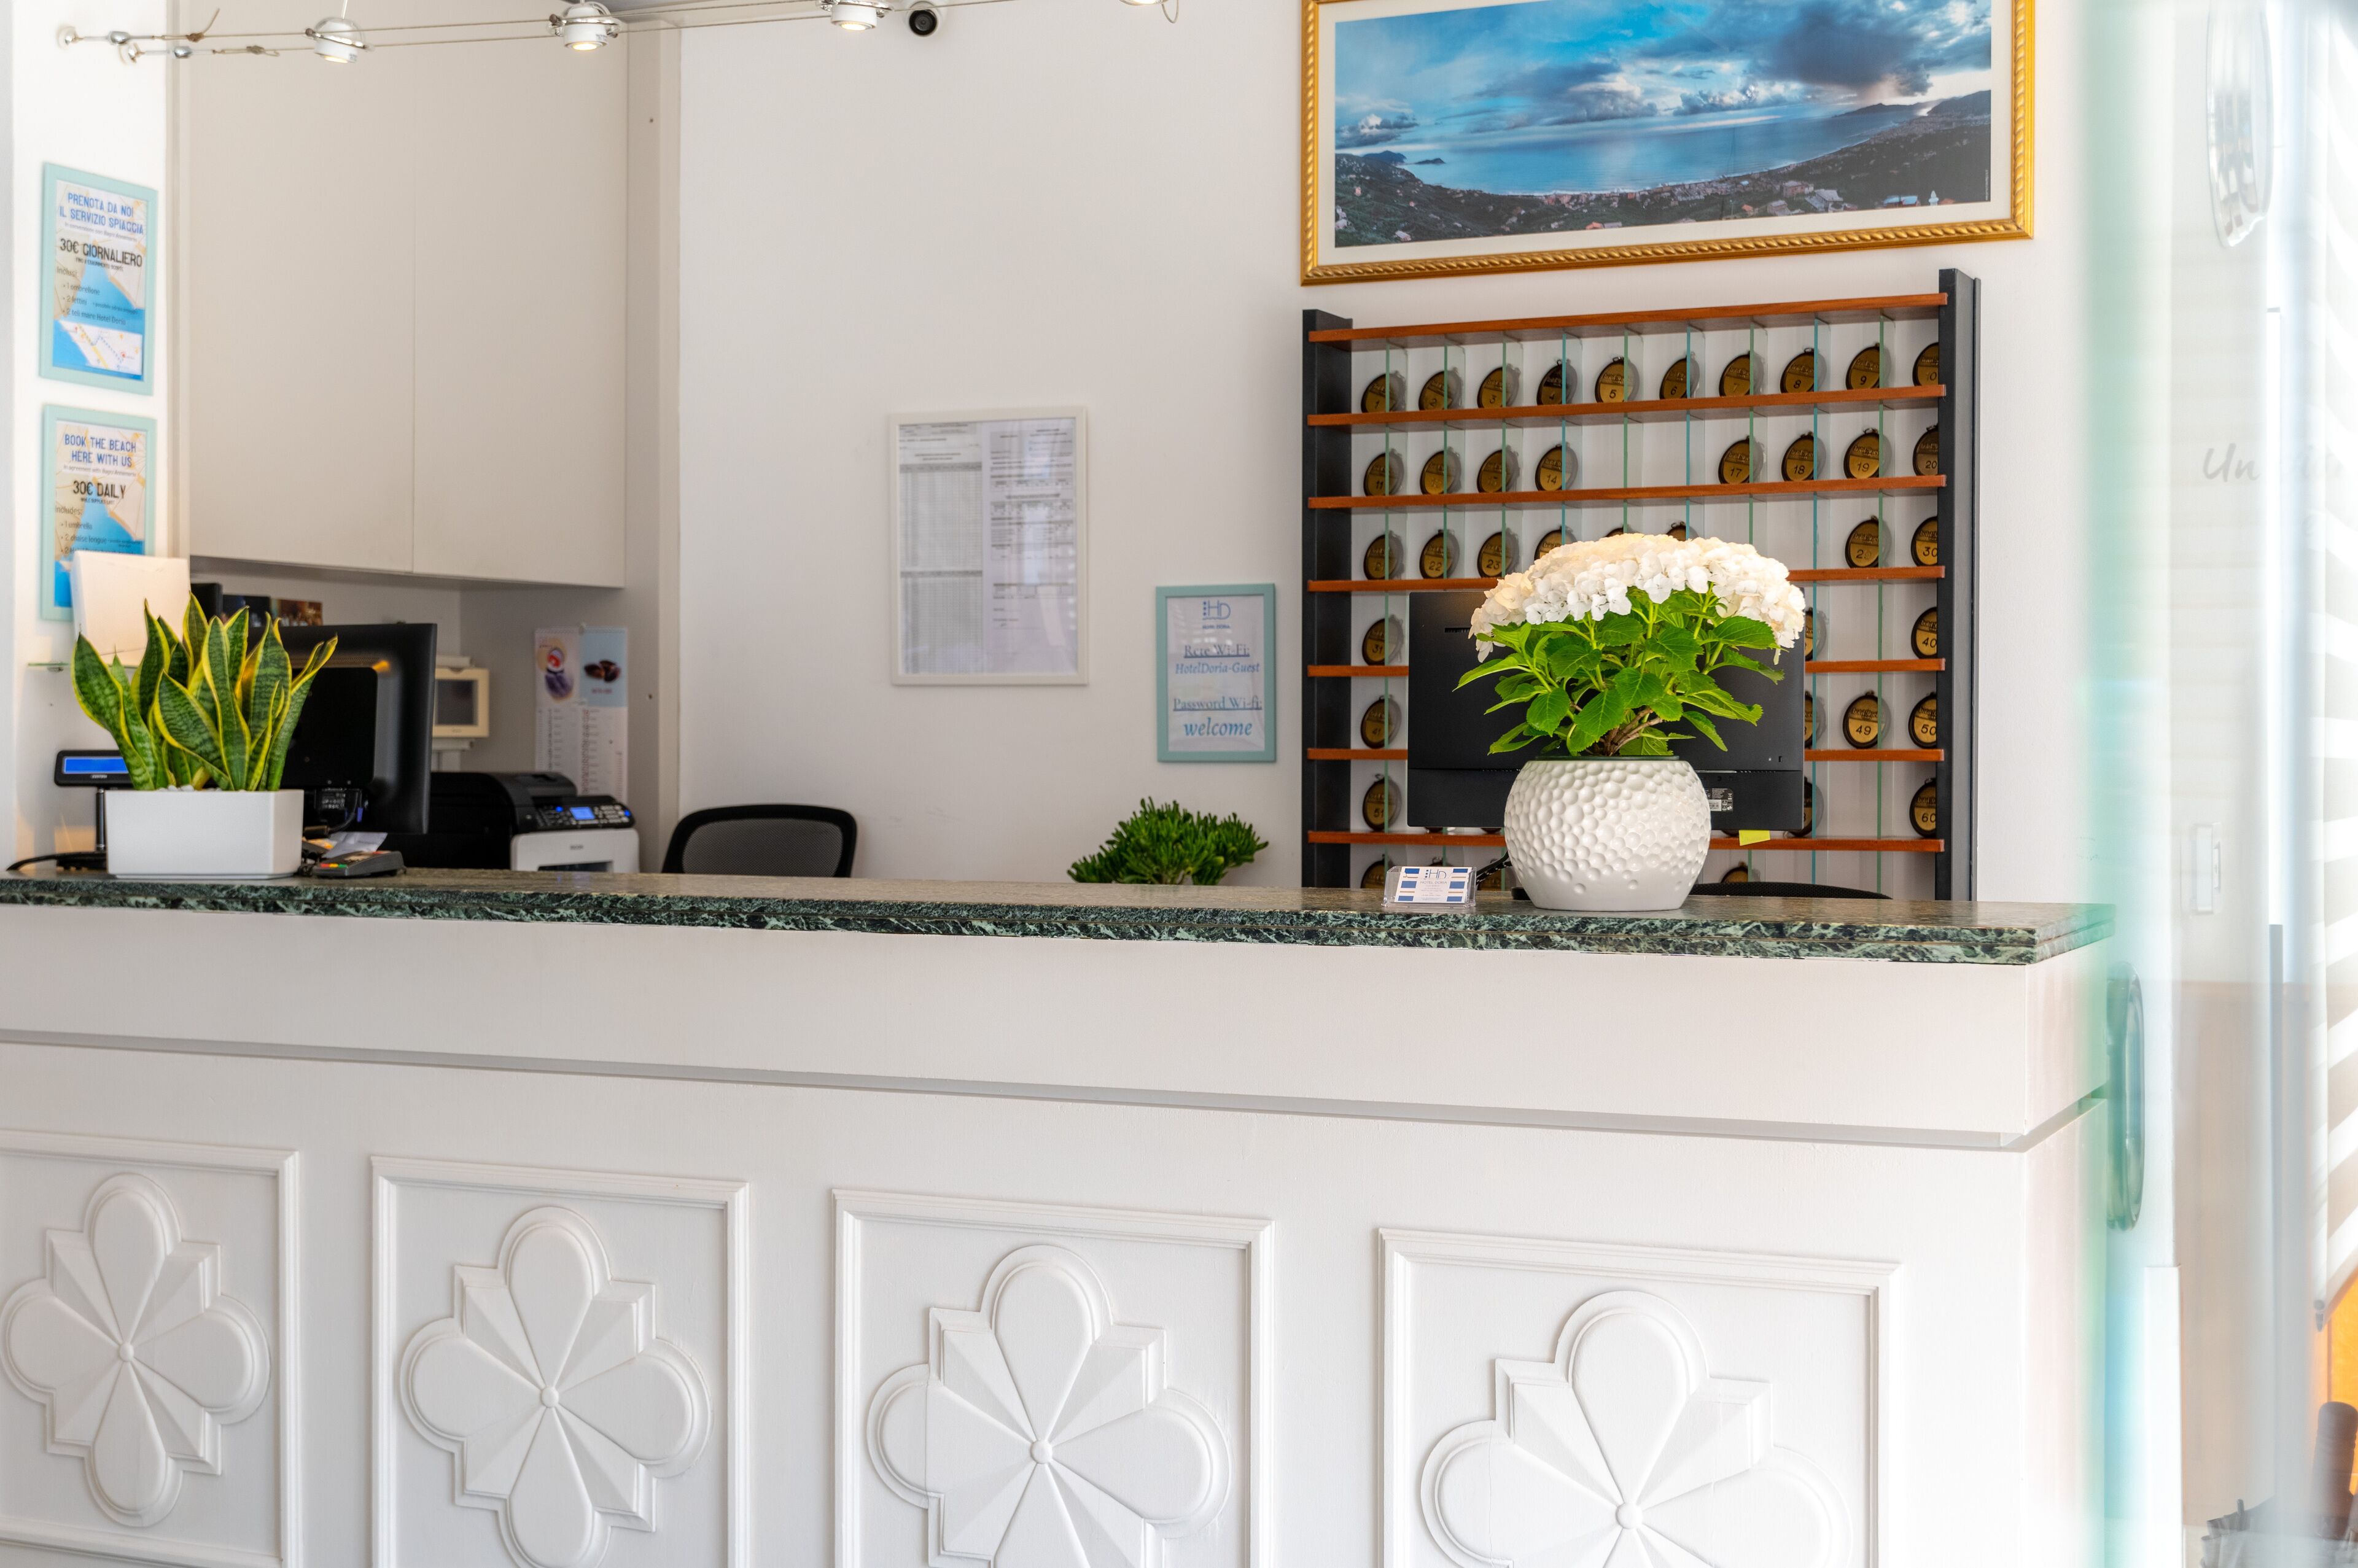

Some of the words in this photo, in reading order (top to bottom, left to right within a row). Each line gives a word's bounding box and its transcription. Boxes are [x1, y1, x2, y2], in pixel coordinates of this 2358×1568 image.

[68, 192, 104, 211] PRENOTA
[107, 202, 118, 214] DA
[121, 204, 134, 217] NOI
[60, 206, 66, 217] IL
[71, 208, 106, 227] SERVIZIO
[109, 217, 144, 235] SPIAGGIA
[60, 238, 79, 254] 30€
[82, 243, 143, 268] GIORNALIERO
[97, 314, 111, 322] Hotel
[1794, 379, 1801, 389] 8
[1860, 376, 1867, 386] 9
[1609, 389, 1617, 399] 5
[1670, 386, 1677, 395] 6
[1490, 394, 1496, 404] 3
[64, 433, 87, 448] BOOK
[90, 437, 106, 449] THE
[109, 440, 137, 453] BEACH
[72, 451, 93, 464] HERE
[97, 452, 119, 466] WITH
[122, 456, 133, 467] US
[1925, 460, 1937, 469] 20
[1730, 467, 1742, 478] 17
[1793, 465, 1805, 475] 18
[1857, 462, 1870, 472] 19
[1547, 474, 1558, 484] 14
[72, 480, 94, 495] 30€
[96, 483, 126, 499] DAILY
[1376, 481, 1383, 489] 11
[1923, 546, 1937, 557] 30
[1429, 561, 1442, 571] 22
[1486, 559, 1501, 570] 23
[1922, 637, 1937, 648] 40
[1175, 661, 1260, 675] HotelDoria-Guest
[1173, 696, 1226, 710] Password
[1183, 716, 1253, 737] welcome
[1856, 724, 1872, 736] 49
[1920, 723, 1936, 736] 50
[1374, 807, 1384, 818] 51
[1921, 812, 1936, 823] 60
[1428, 869, 1447, 879] HD
